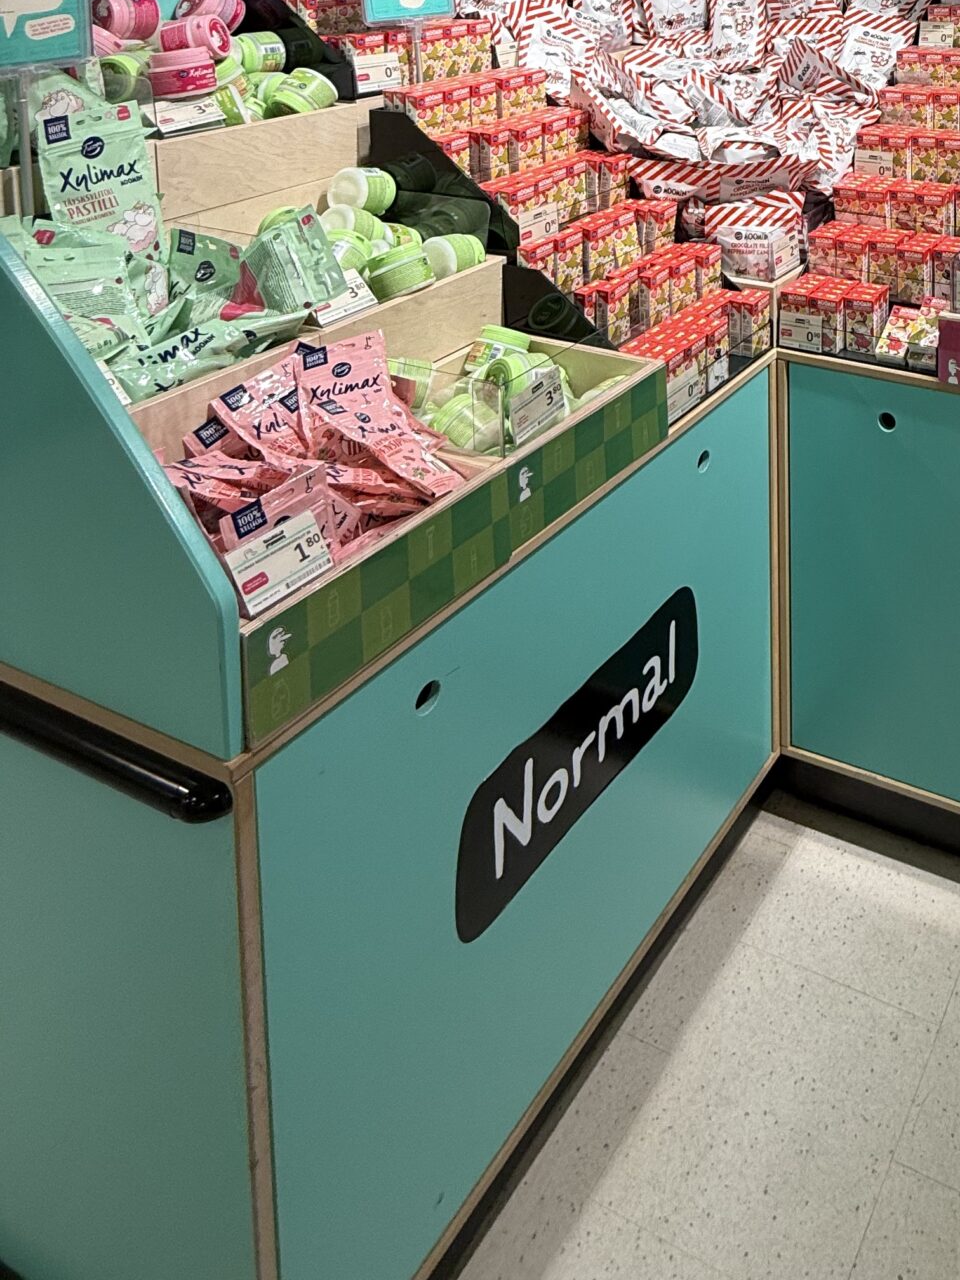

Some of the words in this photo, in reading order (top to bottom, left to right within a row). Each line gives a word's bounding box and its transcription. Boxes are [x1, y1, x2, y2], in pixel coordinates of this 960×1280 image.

[47, 123, 66, 134] 100%
[60, 160, 140, 193] Xylimax
[121, 175, 143, 186] MOOMIN
[663, 186, 688, 196] MOOMIN
[67, 195, 119, 220] PASTILLI
[306, 353, 325, 363] 100%
[310, 373, 381, 404] Xylimax
[238, 509, 262, 527] 100%
[494, 620, 676, 879] Normal
